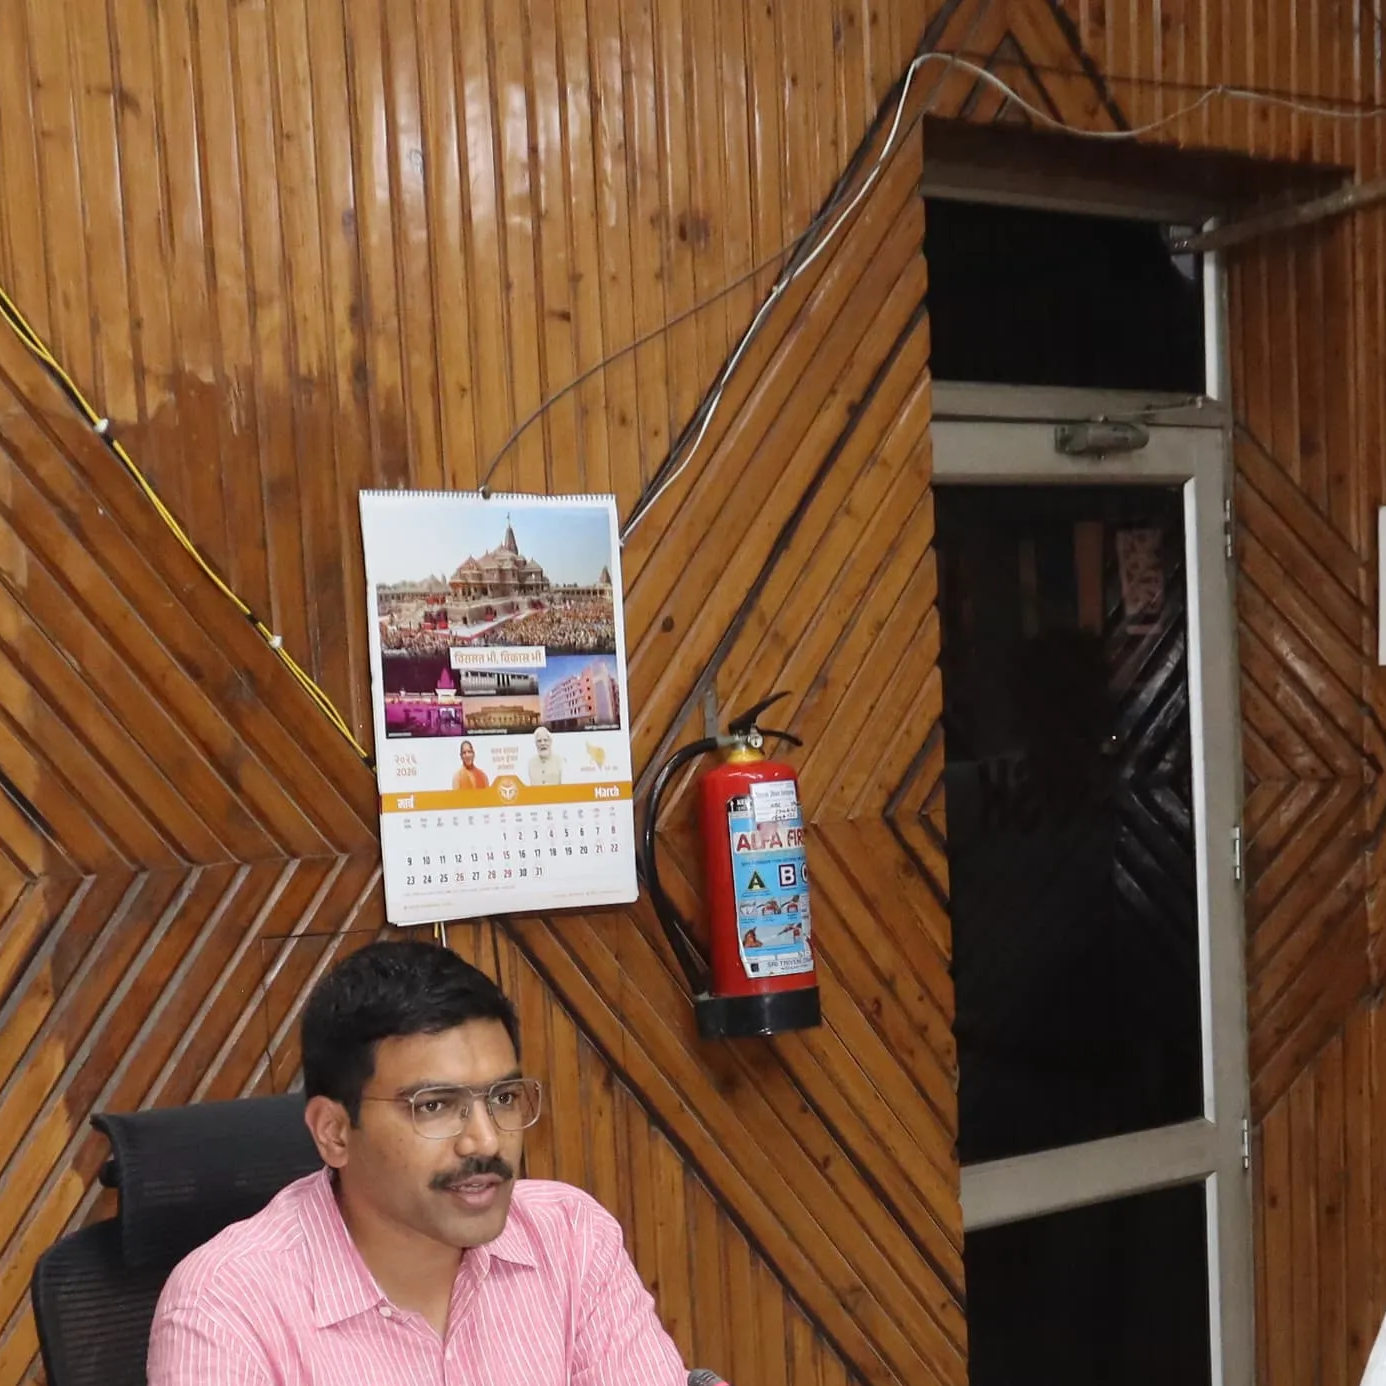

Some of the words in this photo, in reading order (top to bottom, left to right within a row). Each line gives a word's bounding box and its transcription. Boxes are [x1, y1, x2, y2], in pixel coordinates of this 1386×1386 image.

[595, 785, 620, 799] March
[518, 831, 523, 840] 2
[533, 830, 538, 839] 3
[549, 829, 554, 838] 4
[564, 828, 569, 837] 5
[579, 827, 584, 837] 6
[595, 826, 600, 835] 7
[407, 856, 412, 866] 9
[423, 855, 430, 865] 10
[440, 855, 446, 864] 11
[454, 854, 462, 863] 12
[470, 852, 478, 862] 13
[486, 851, 494, 861] 14
[503, 850, 510, 860] 15
[518, 850, 526, 859] 16
[534, 848, 541, 858] 17
[549, 847, 557, 857] 18
[565, 846, 572, 856] 19
[579, 845, 588, 855] 20
[596, 844, 603, 854] 21
[610, 843, 618, 853] 22
[406, 875, 415, 885] 23
[423, 874, 432, 884] 24
[439, 873, 448, 883] 25
[456, 872, 465, 882] 26
[472, 871, 480, 881] 27
[487, 870, 496, 880] 28
[503, 869, 512, 879] 29
[519, 868, 527, 878] 30
[535, 867, 543, 876] 31
[780, 866, 795, 886] B
